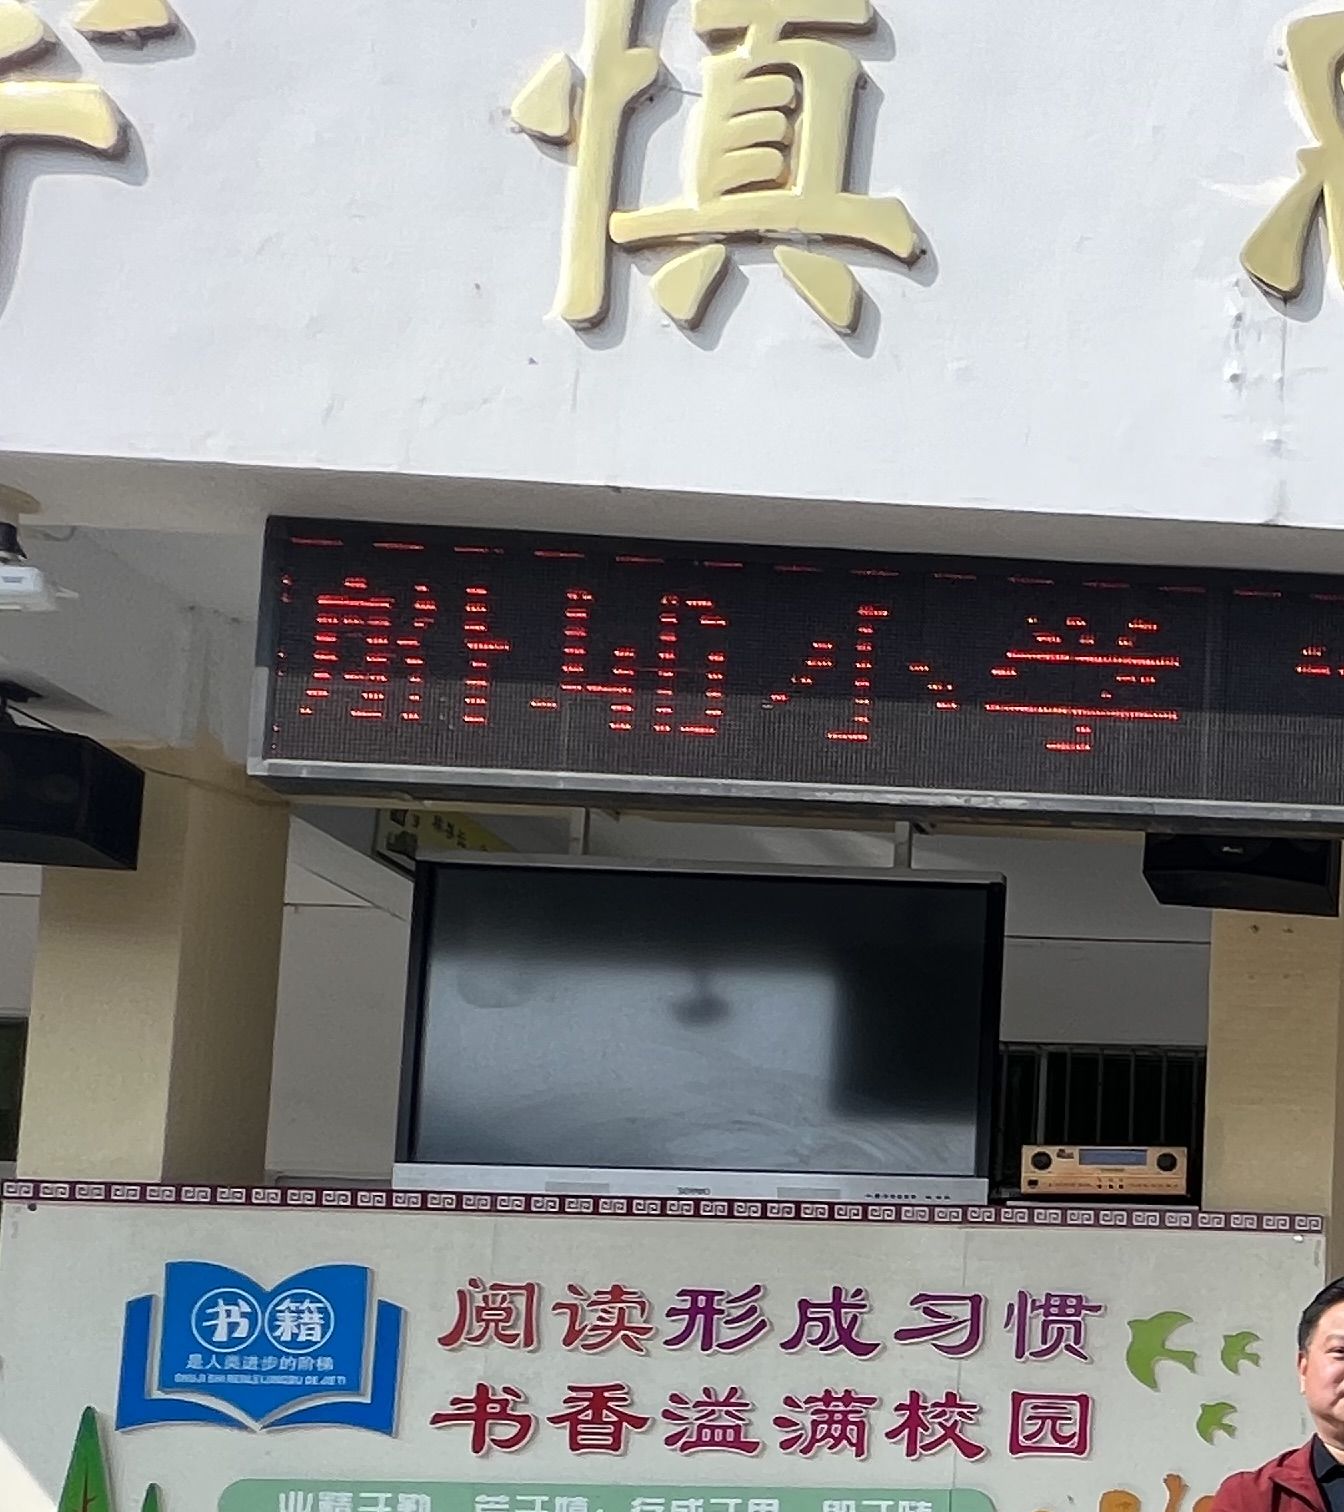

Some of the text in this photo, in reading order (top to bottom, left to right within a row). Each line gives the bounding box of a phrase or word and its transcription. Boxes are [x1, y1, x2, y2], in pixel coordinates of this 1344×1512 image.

[203, 1298, 327, 1343] 书籍
[437, 1279, 1104, 1362] 阅读形成习惯
[185, 1353, 335, 1372] 是人类进步的阶梯
[428, 1384, 1096, 1461] 书香溢满校园
